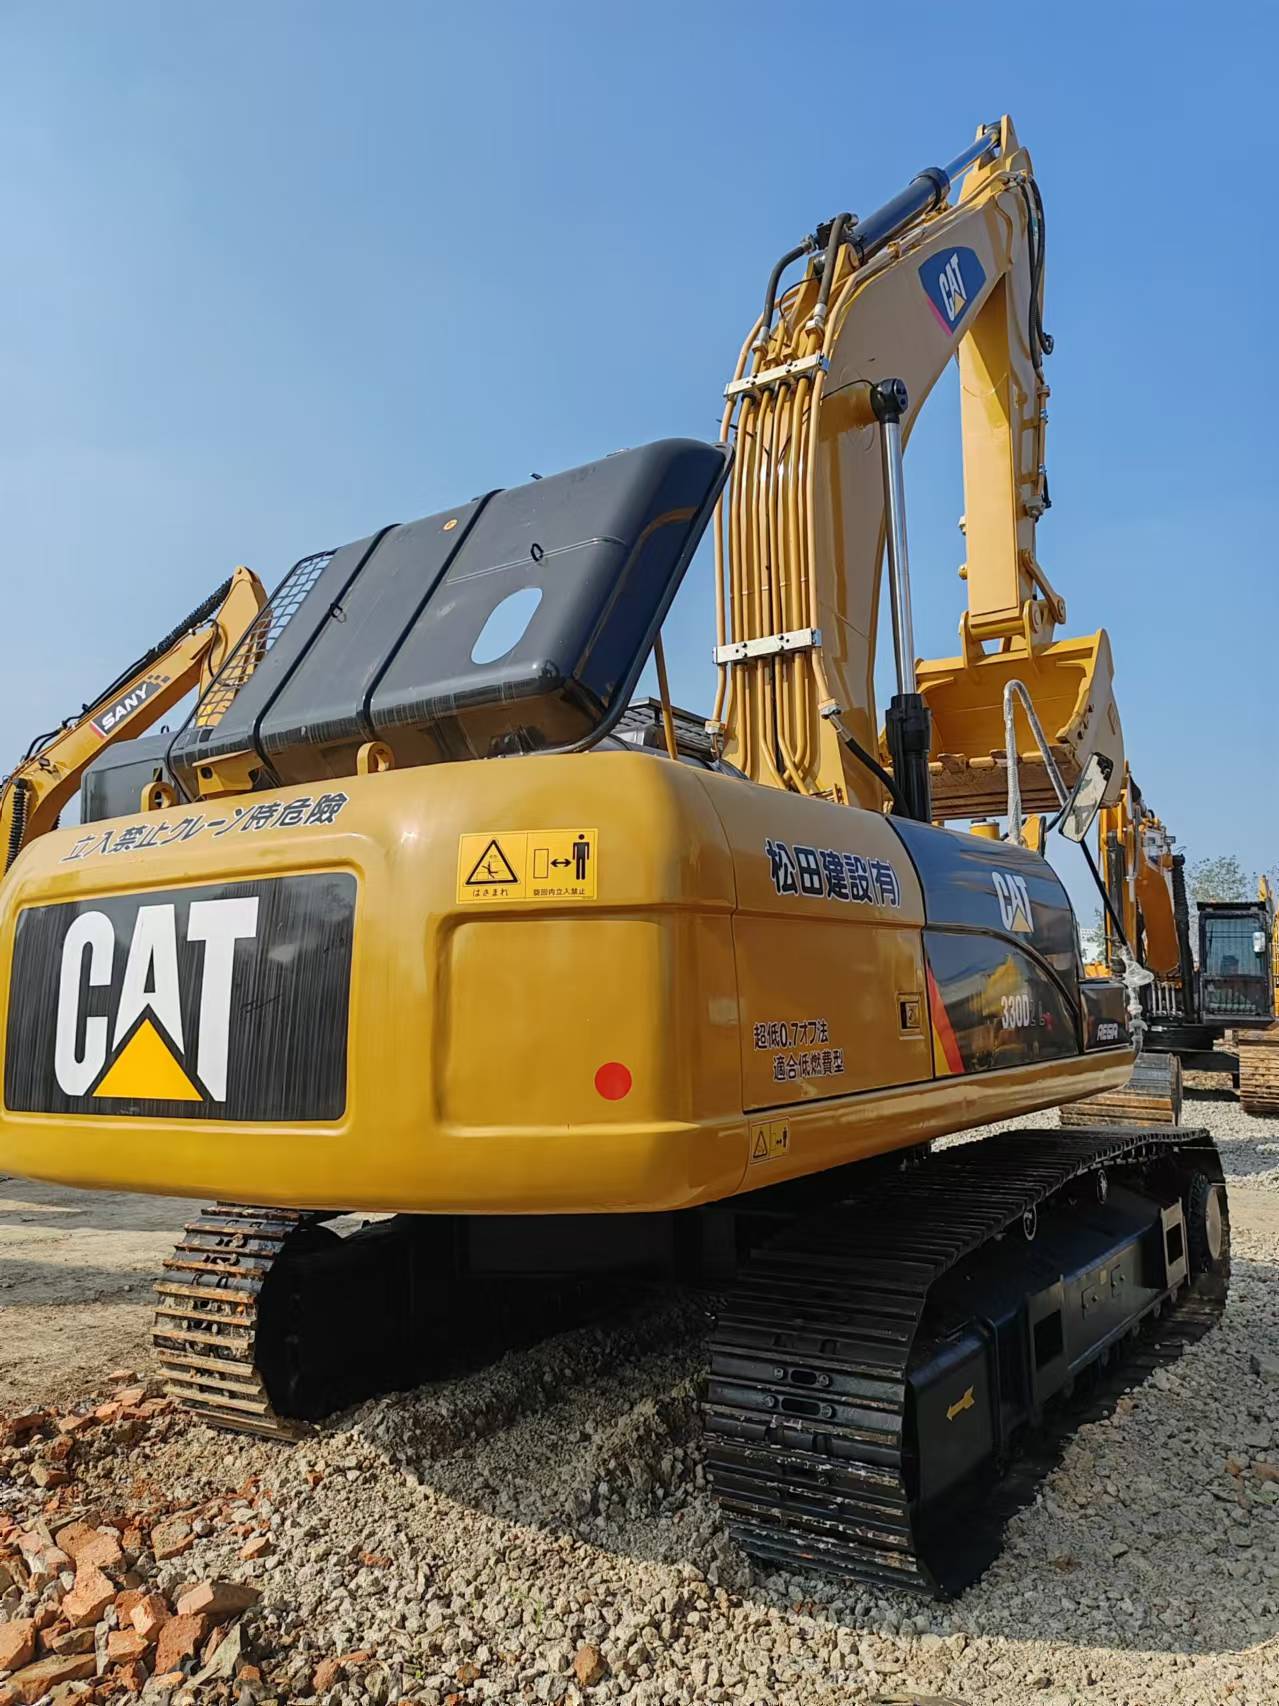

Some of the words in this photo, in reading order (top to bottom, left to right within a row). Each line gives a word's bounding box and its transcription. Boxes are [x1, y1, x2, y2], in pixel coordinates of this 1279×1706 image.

[939, 252, 967, 321] CAT
[101, 683, 147, 731] SANY
[472, 888, 509, 897] はさまれ
[992, 871, 1034, 932] CAT
[55, 896, 259, 1102] CAT
